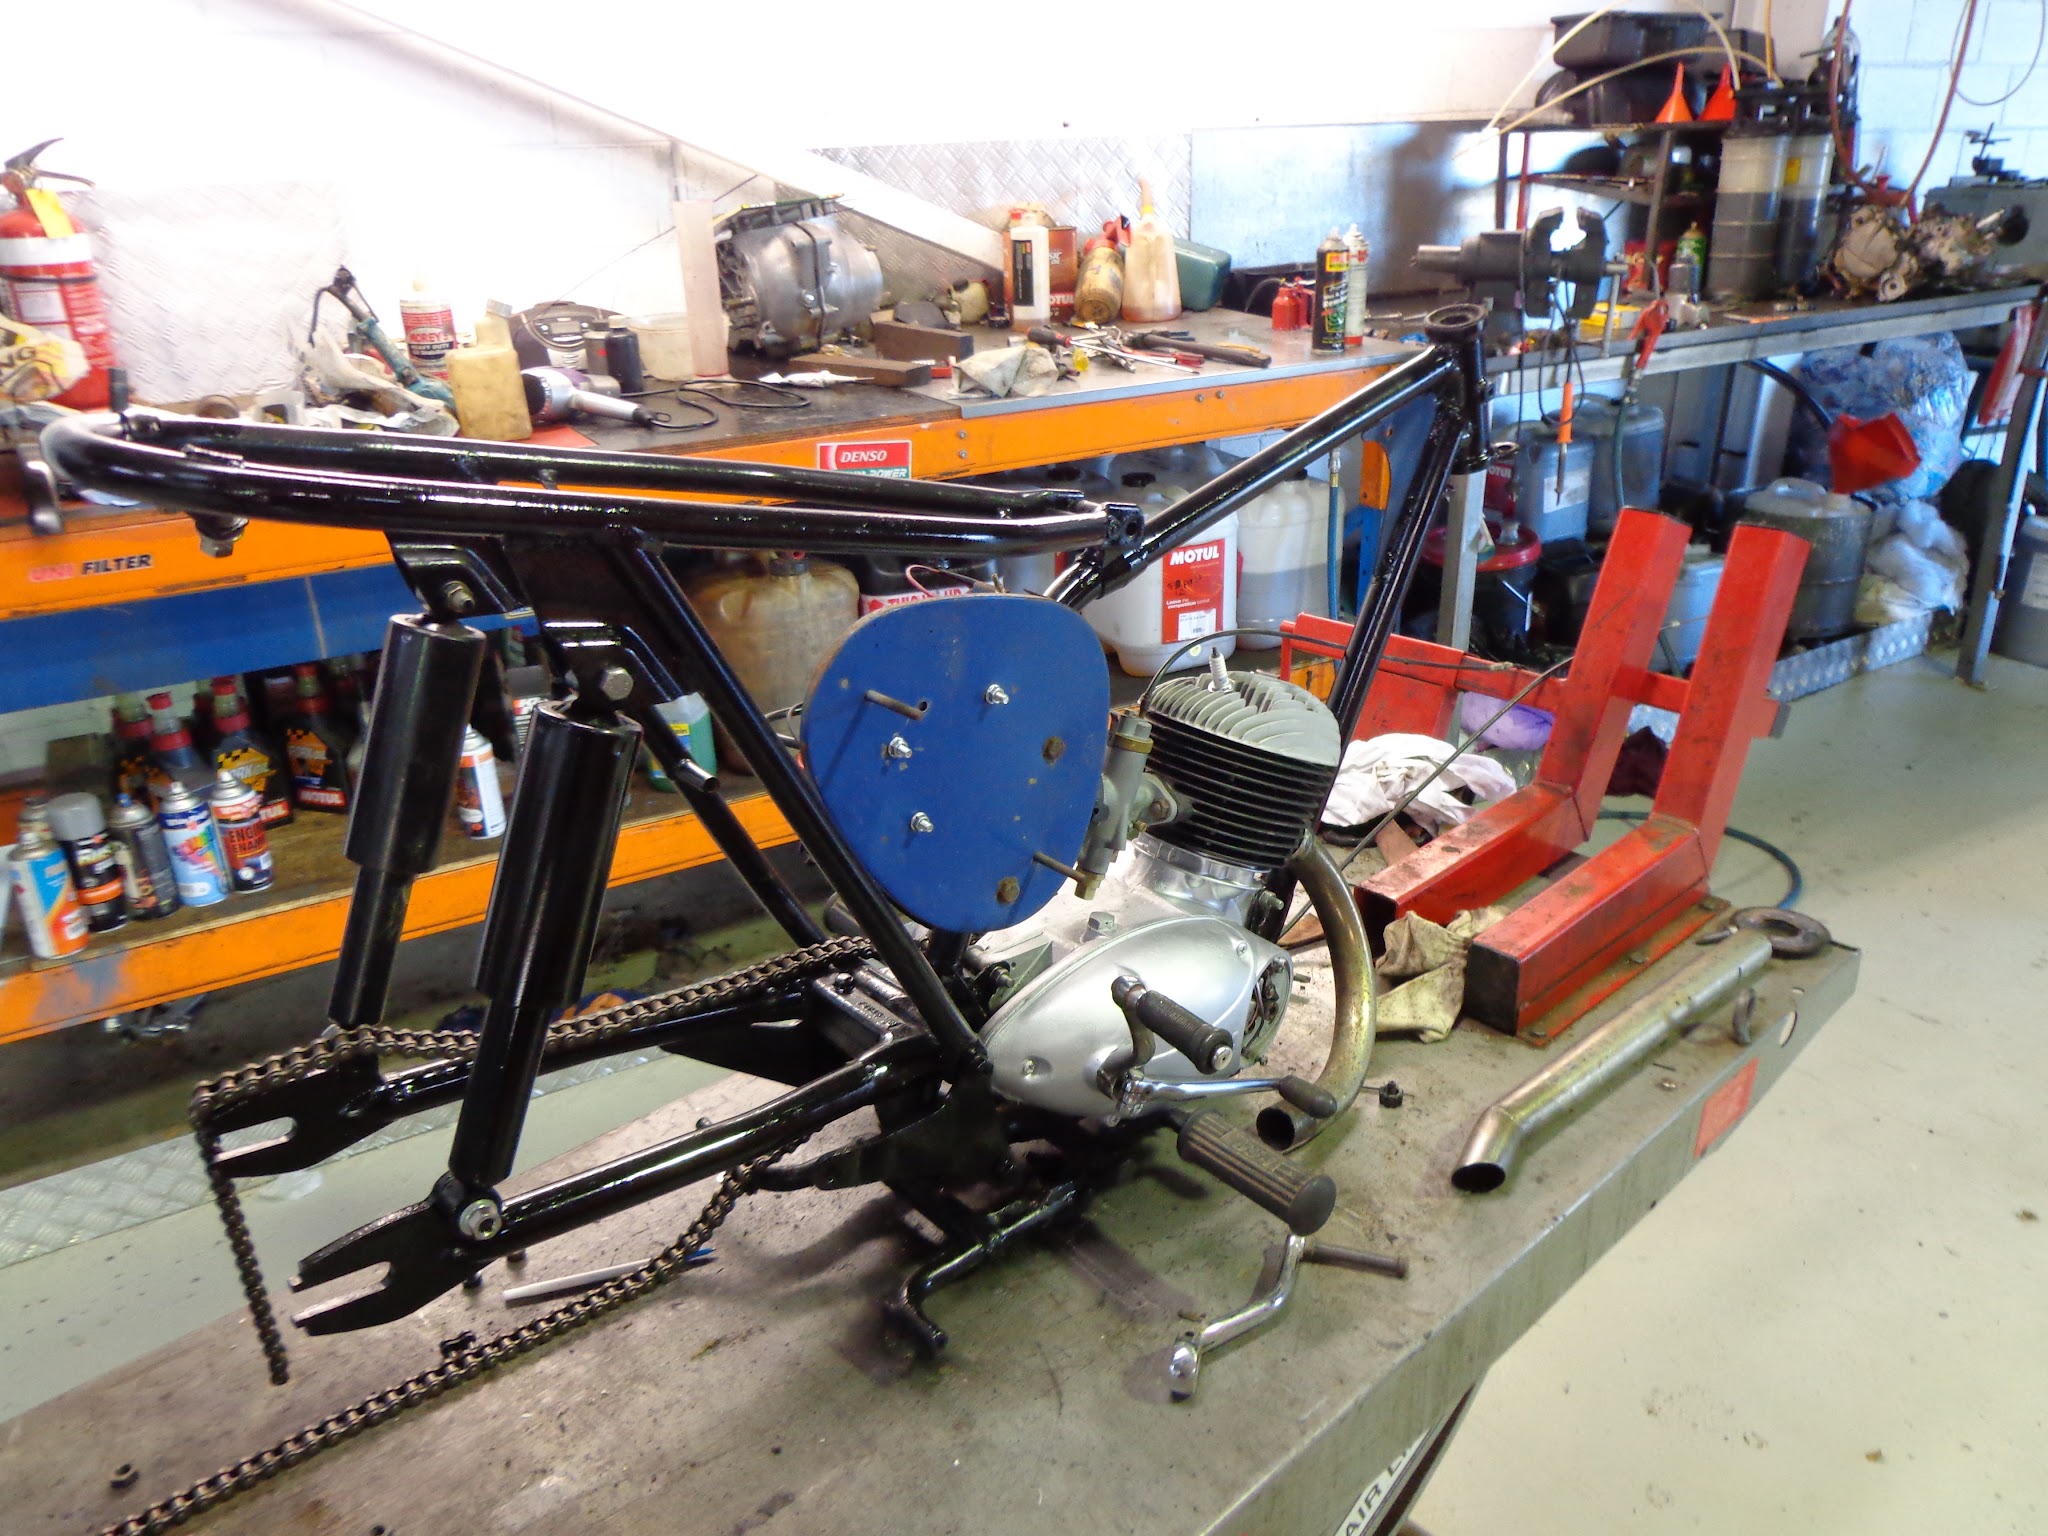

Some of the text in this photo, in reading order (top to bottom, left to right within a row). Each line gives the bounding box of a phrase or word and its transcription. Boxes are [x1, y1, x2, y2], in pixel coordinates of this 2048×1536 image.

[1049, 293, 1074, 305] OTUL
[841, 450, 887, 463] DENSO
[1488, 466, 1512, 479] OTUL
[1169, 545, 1219, 566] MOTUL
[81, 554, 152, 575] FILTER
